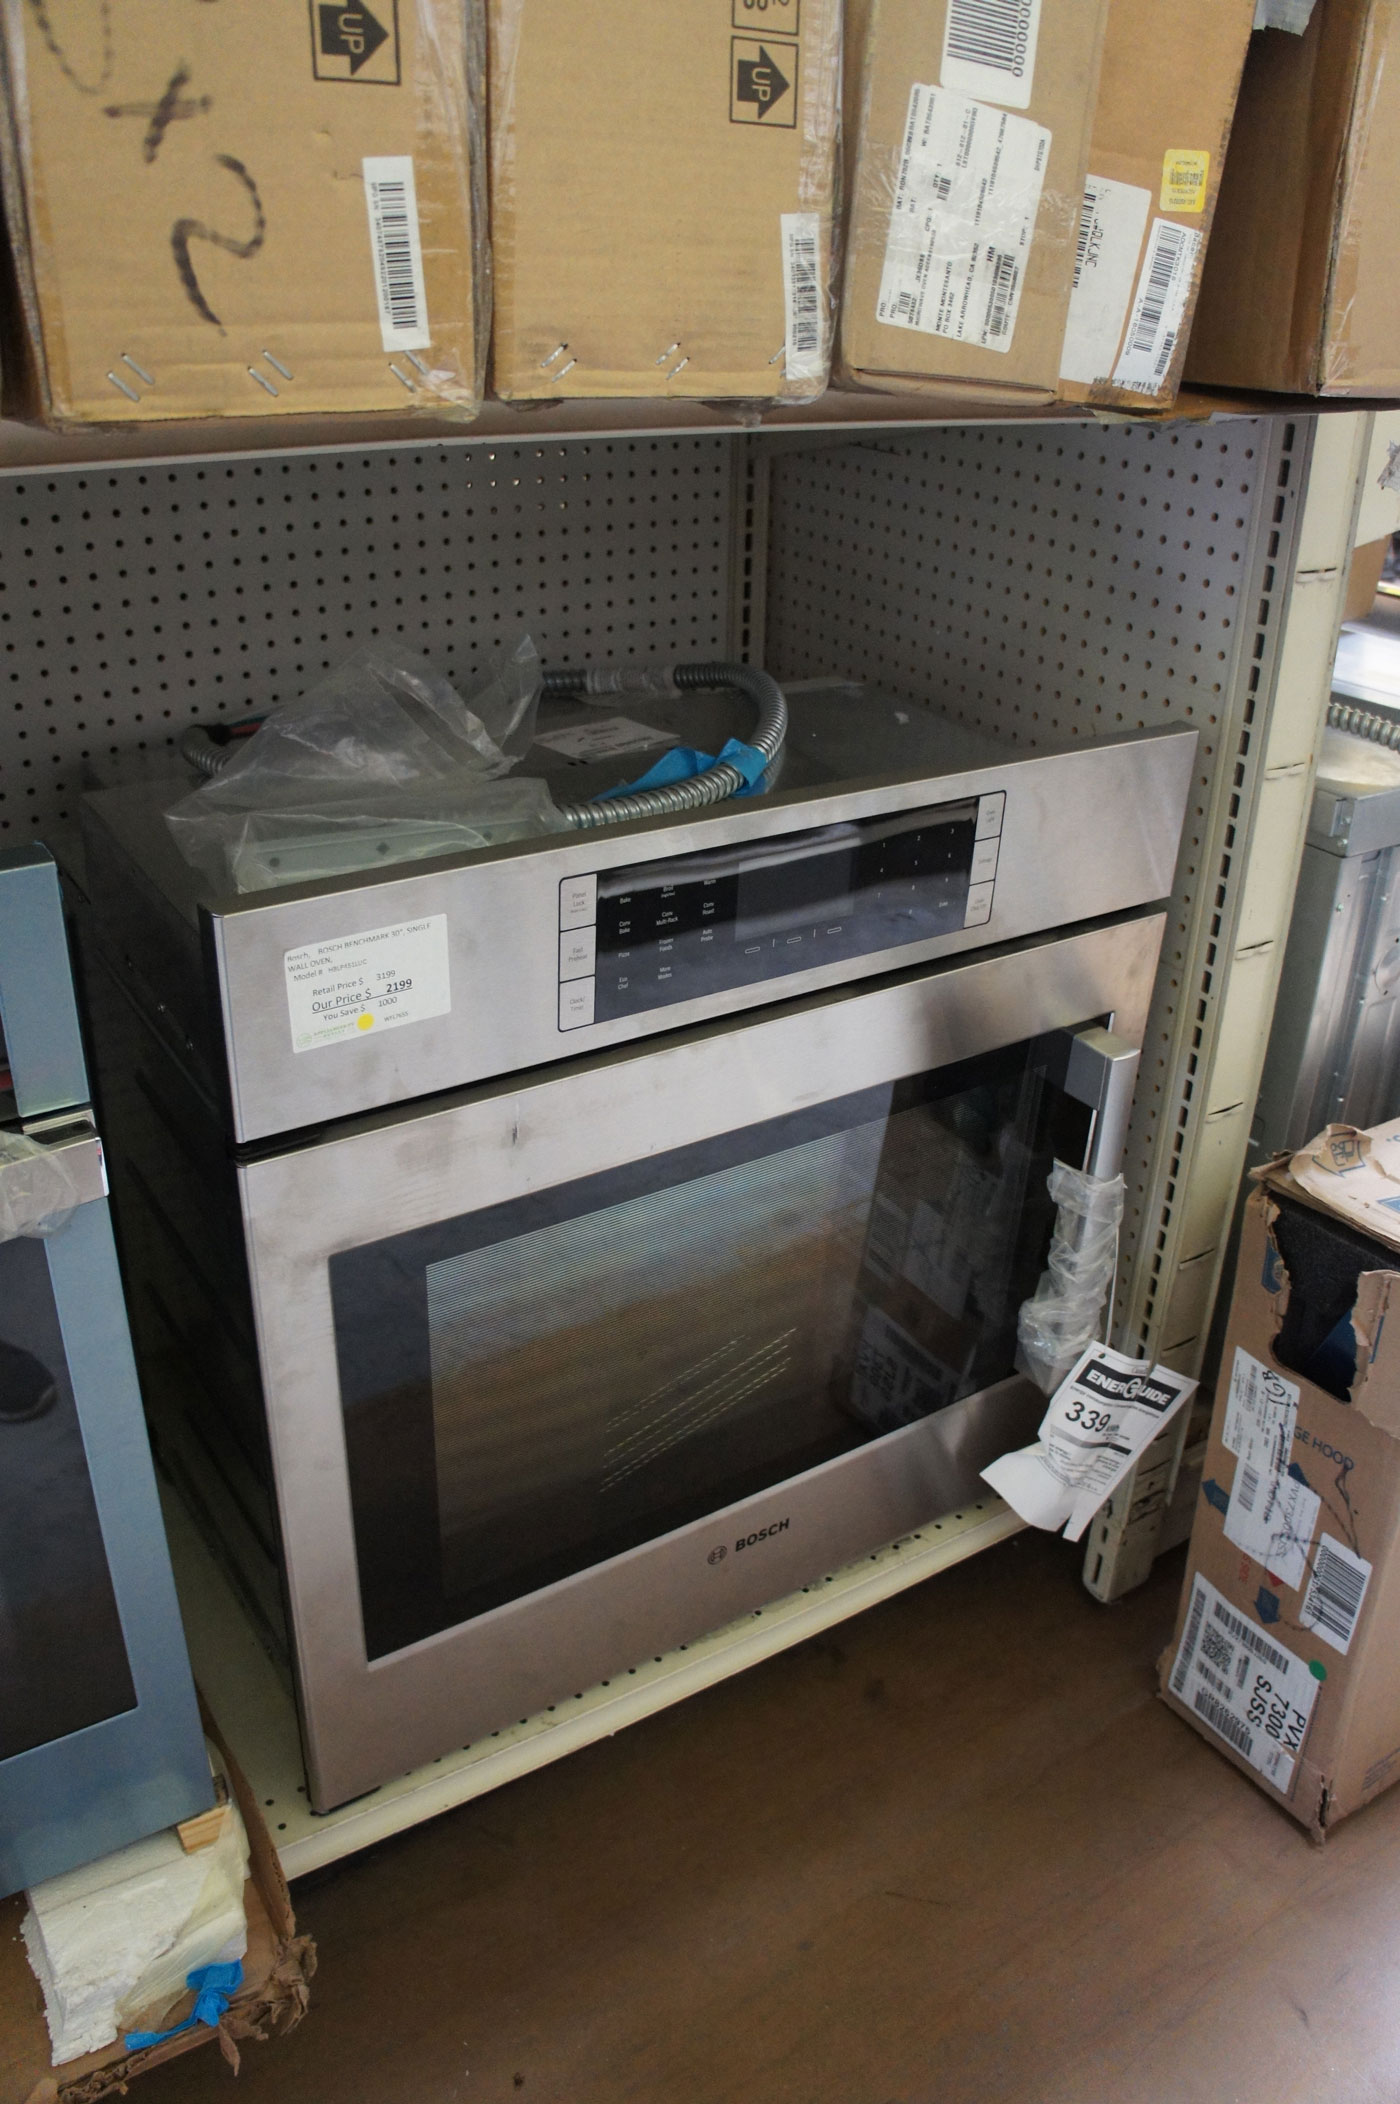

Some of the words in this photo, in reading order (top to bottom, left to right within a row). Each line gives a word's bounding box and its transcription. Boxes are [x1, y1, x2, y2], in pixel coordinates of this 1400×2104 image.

[338, 13, 364, 54] UP
[752, 67, 771, 101] UP
[969, 264, 975, 272] CA
[986, 245, 996, 262] HM
[935, 308, 944, 331] MONTE
[940, 260, 952, 306] MONTESANTO
[942, 324, 948, 333] PO
[318, 944, 342, 955] BOSCH
[344, 933, 389, 949] BENCHMARK
[407, 923, 430, 933] SINGLE
[287, 963, 308, 972] WALL
[309, 957, 332, 968] OVEN,
[293, 971, 316, 982] Model
[311, 998, 333, 1012] Our
[335, 992, 361, 1006] Price
[365, 988, 371, 999] $
[386, 979, 412, 993] 2199
[312, 985, 335, 996] Retail
[337, 980, 356, 990] Price
[376, 970, 395, 981] 3199
[323, 1012, 338, 1021] You
[340, 1007, 358, 1017] Save
[378, 997, 397, 1007] 1000
[1065, 1401, 1112, 1432] 339
[1312, 1437, 1354, 1471] HOOD
[735, 1517, 790, 1552] BOSCH
[1246, 1674, 1272, 1728] SJSS
[1266, 1693, 1290, 1740] 7300
[1283, 1709, 1306, 1751] PVX
